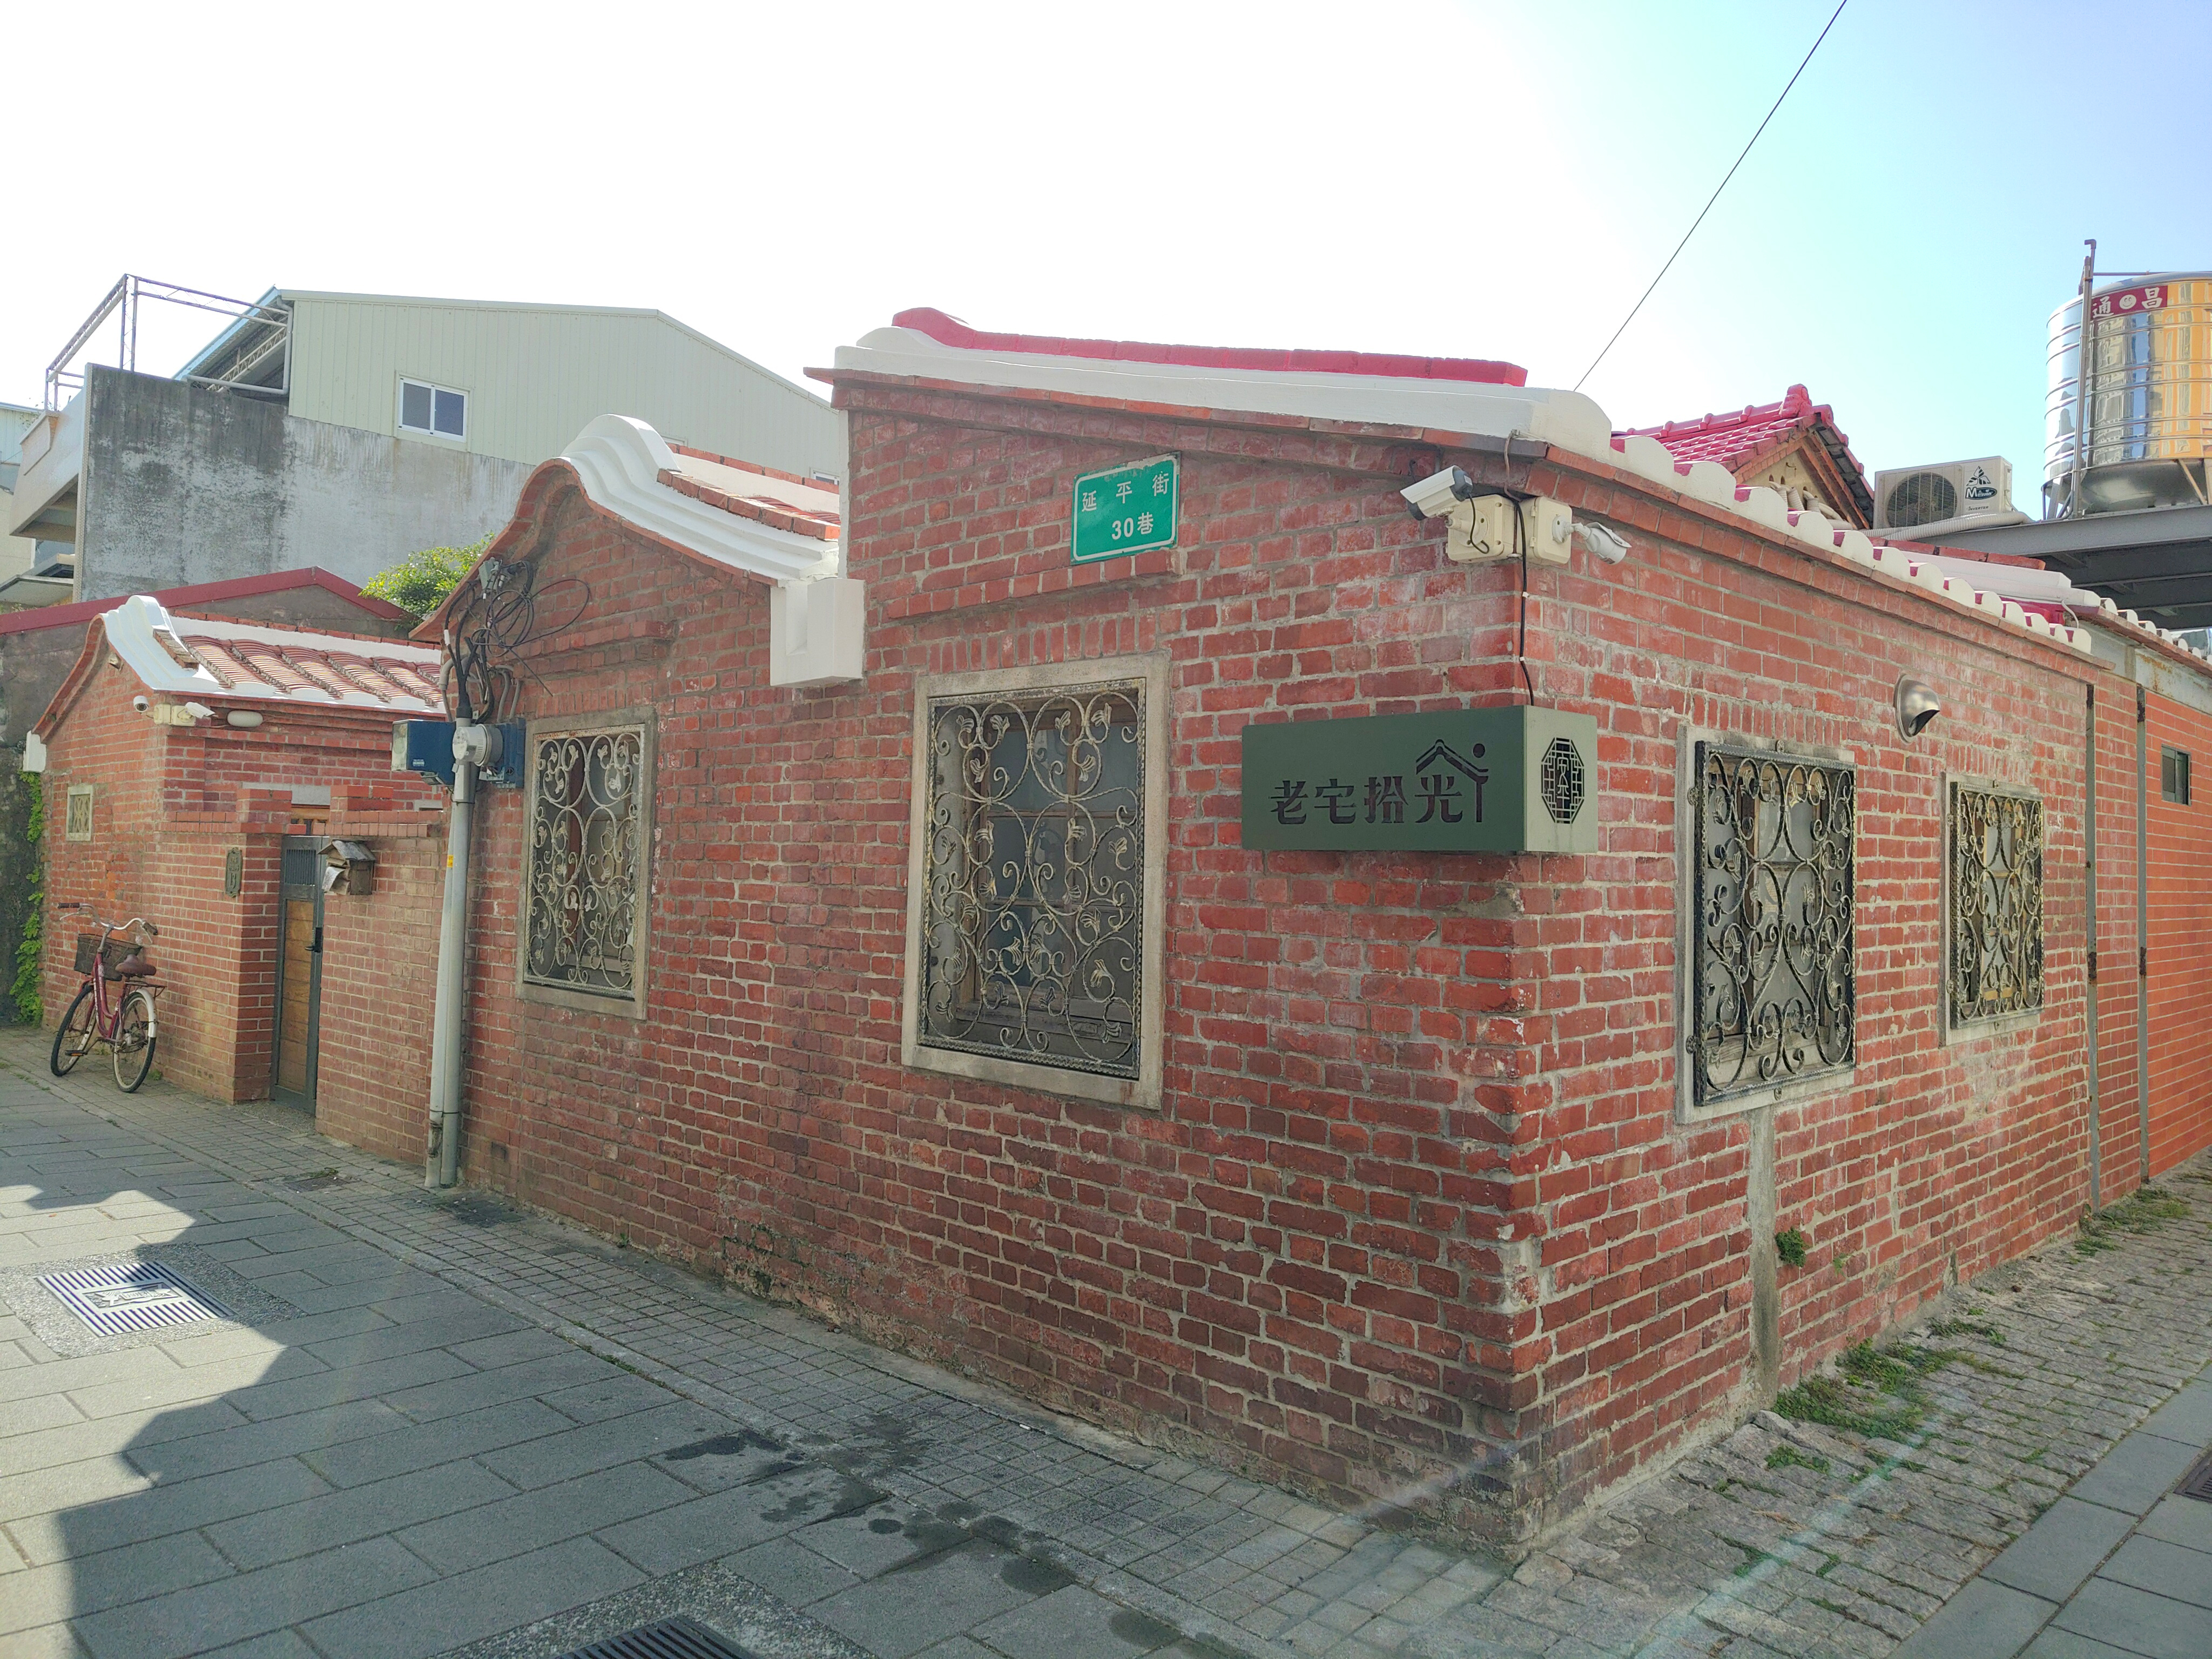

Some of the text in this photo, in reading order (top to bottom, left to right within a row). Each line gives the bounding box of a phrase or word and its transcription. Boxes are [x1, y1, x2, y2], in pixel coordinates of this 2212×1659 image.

[1082, 471, 1169, 512] 延平街
[1111, 512, 1154, 540] 30巷
[1269, 774, 1463, 824] 老宅拾光
